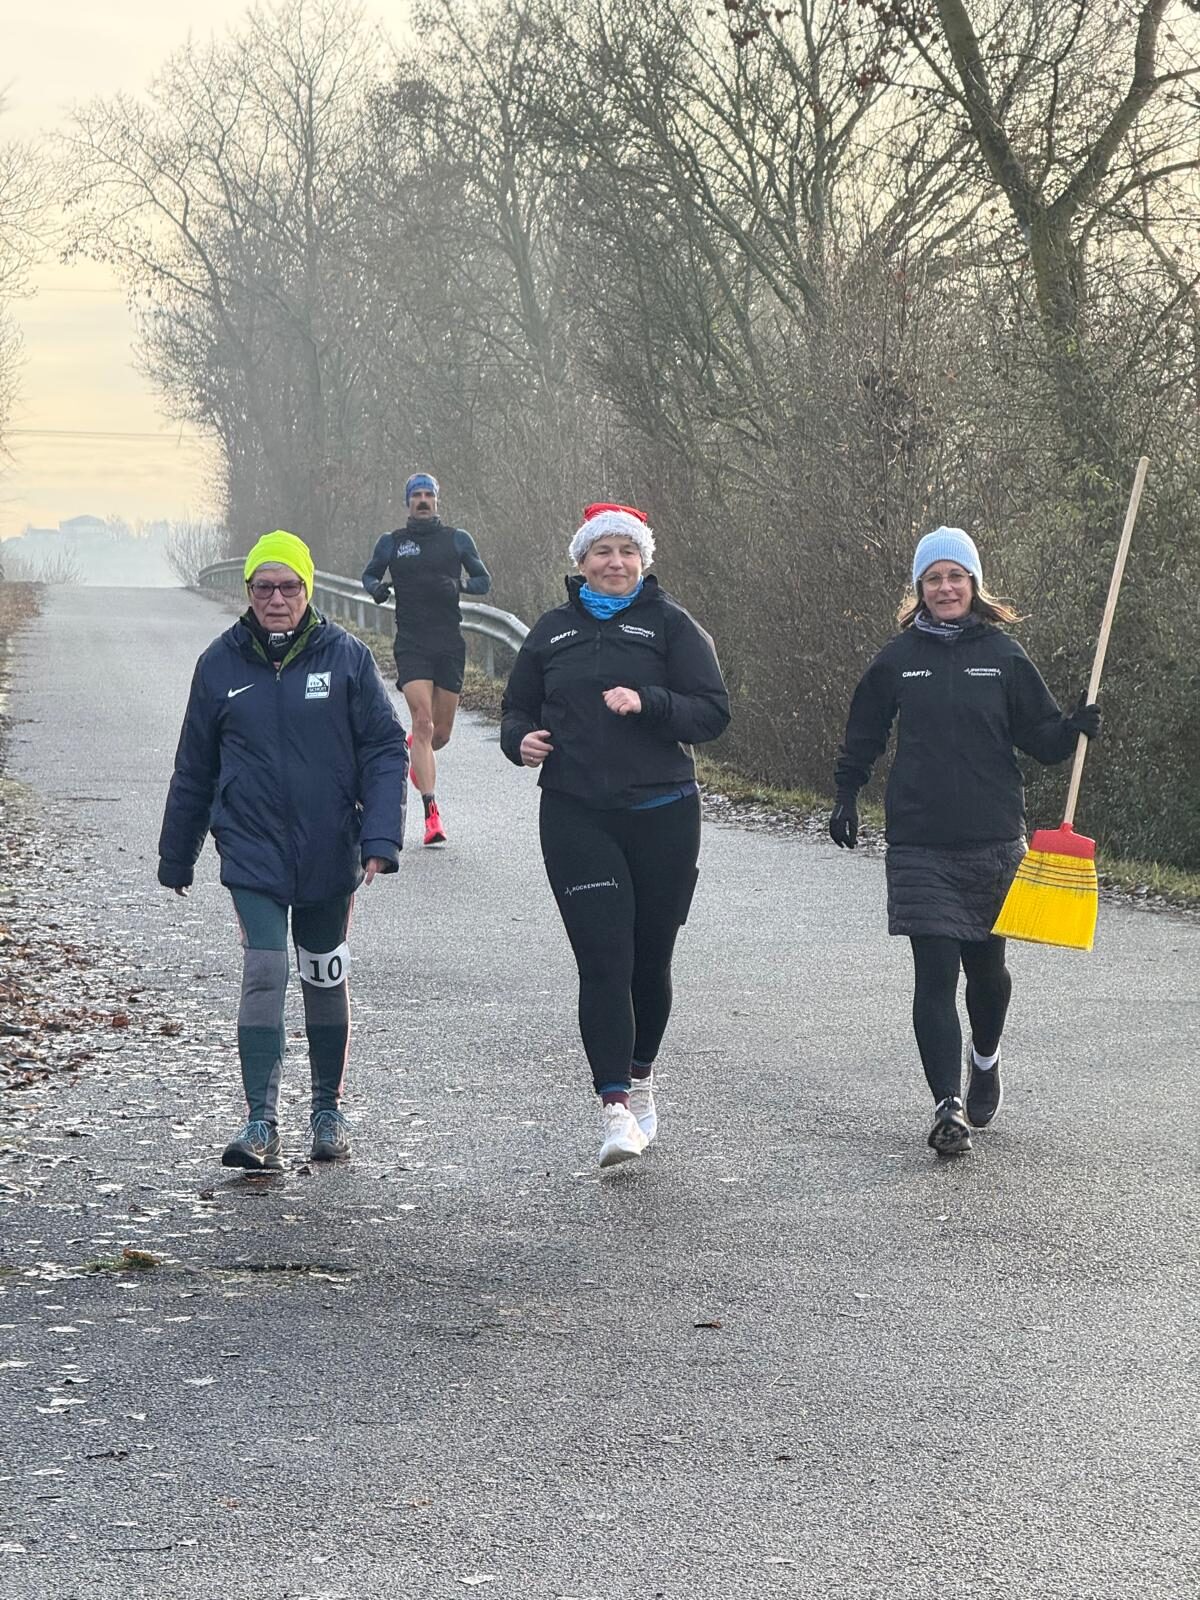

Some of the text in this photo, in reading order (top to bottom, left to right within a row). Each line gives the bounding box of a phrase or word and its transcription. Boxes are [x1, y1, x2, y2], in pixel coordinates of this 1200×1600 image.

[550, 630, 572, 644] CRAFT
[902, 670, 926, 678] CRAFT
[309, 955, 343, 983] 10
